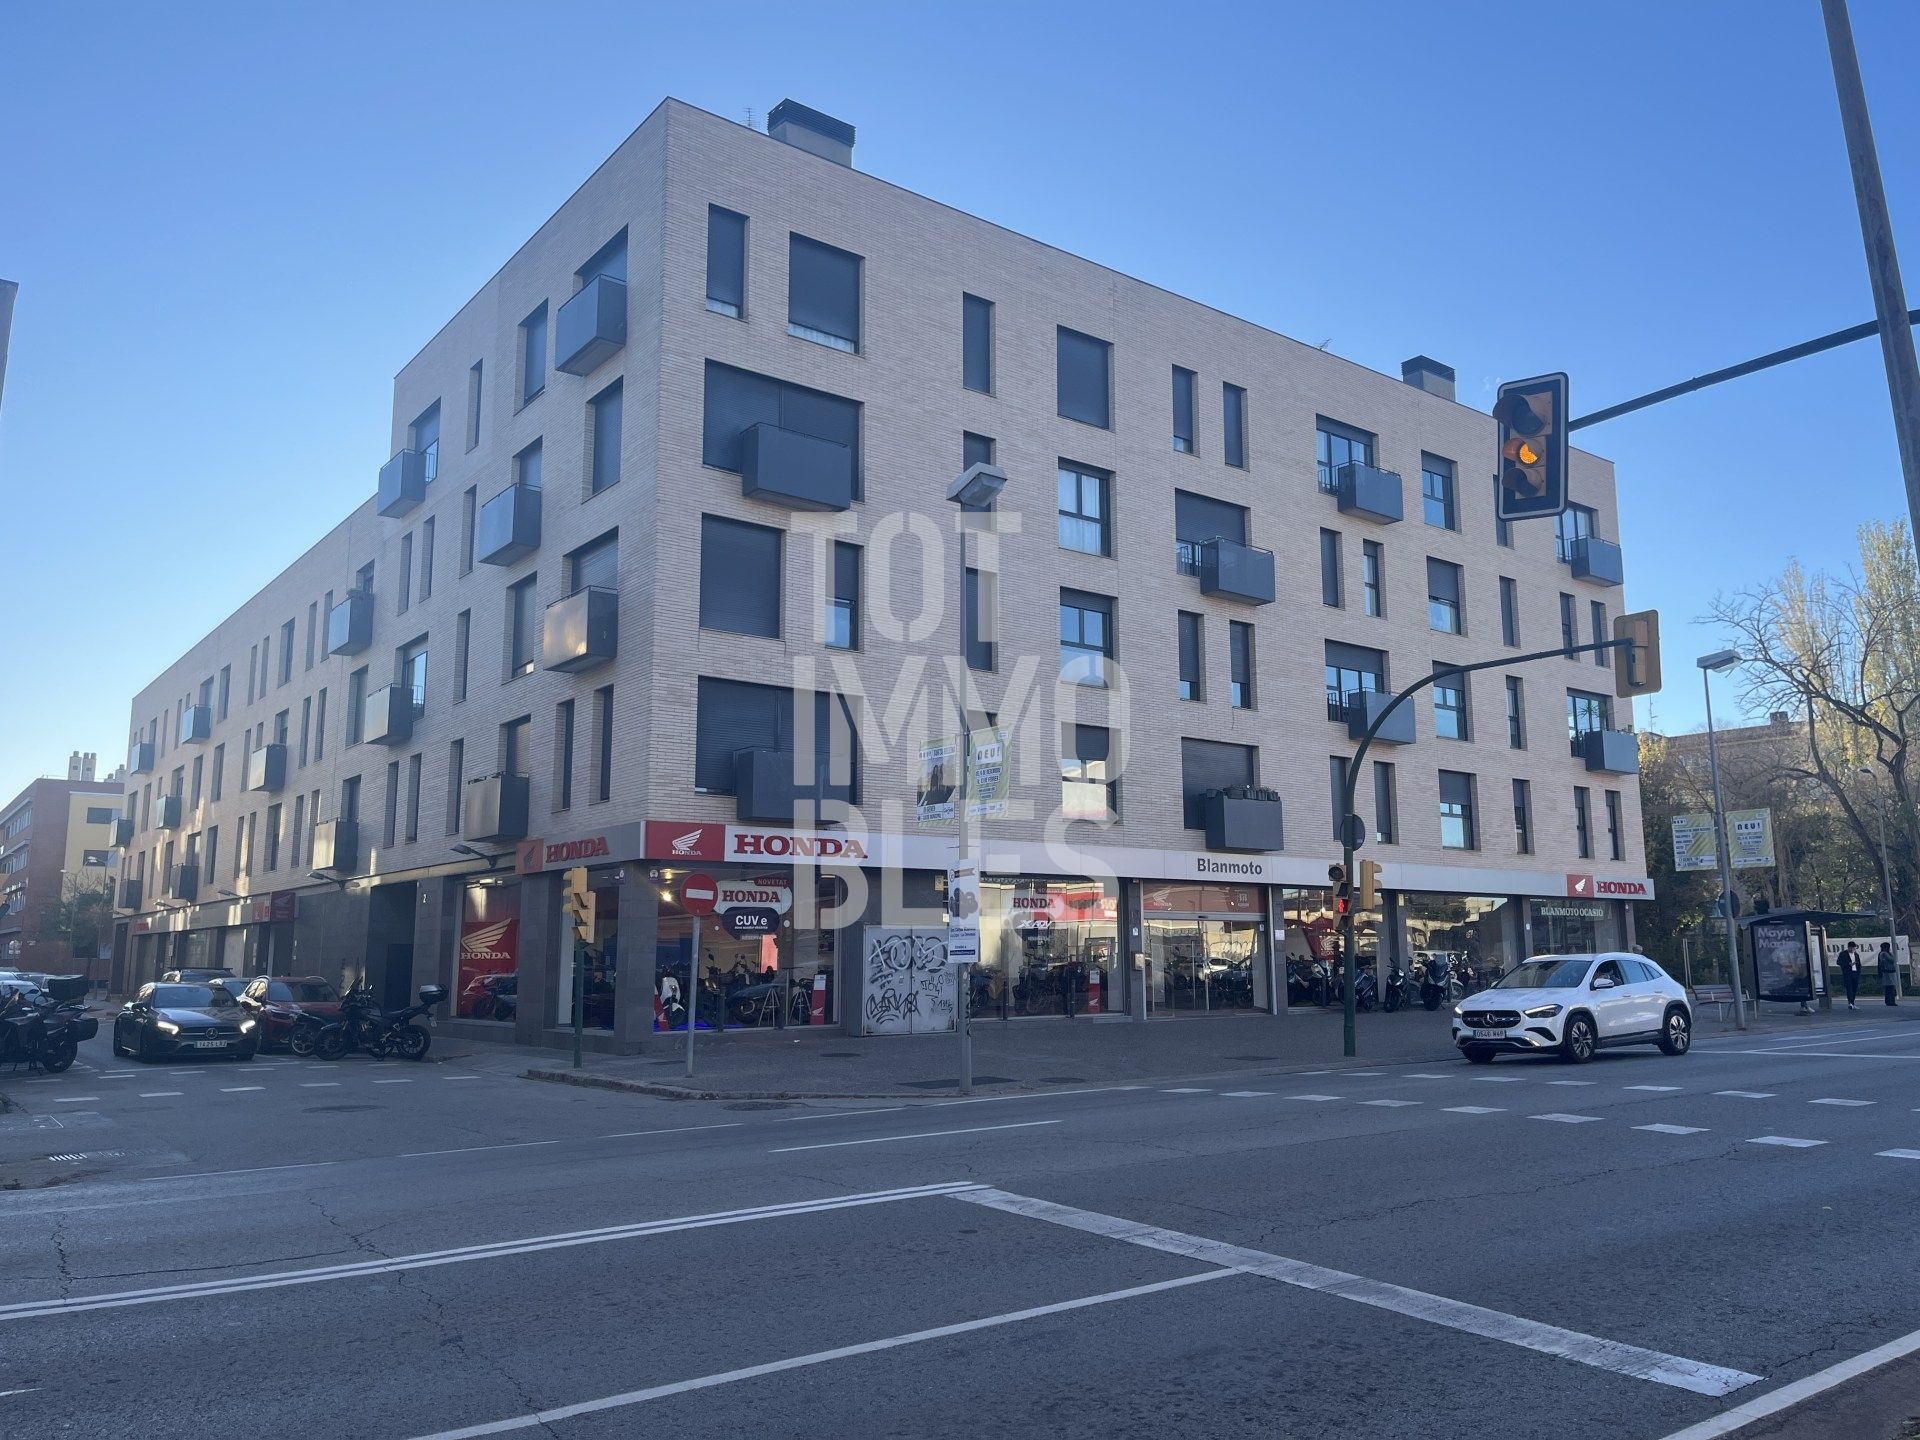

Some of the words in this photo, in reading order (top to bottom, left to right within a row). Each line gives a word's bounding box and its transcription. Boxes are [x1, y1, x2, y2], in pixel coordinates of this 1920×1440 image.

[546, 836, 609, 864] HONDA
[734, 834, 868, 859] HONDA
[1197, 858, 1263, 875] Blanmoto
[1596, 881, 1647, 895] HONDA
[722, 890, 781, 903] HONDA
[1013, 898, 1056, 909] HONDA
[1541, 907, 1579, 916] BLANMOTO
[735, 915, 759, 926] CUV
[760, 917, 768, 925] e
[1758, 928, 1795, 939] Mayte
[461, 952, 511, 960] HONDA
